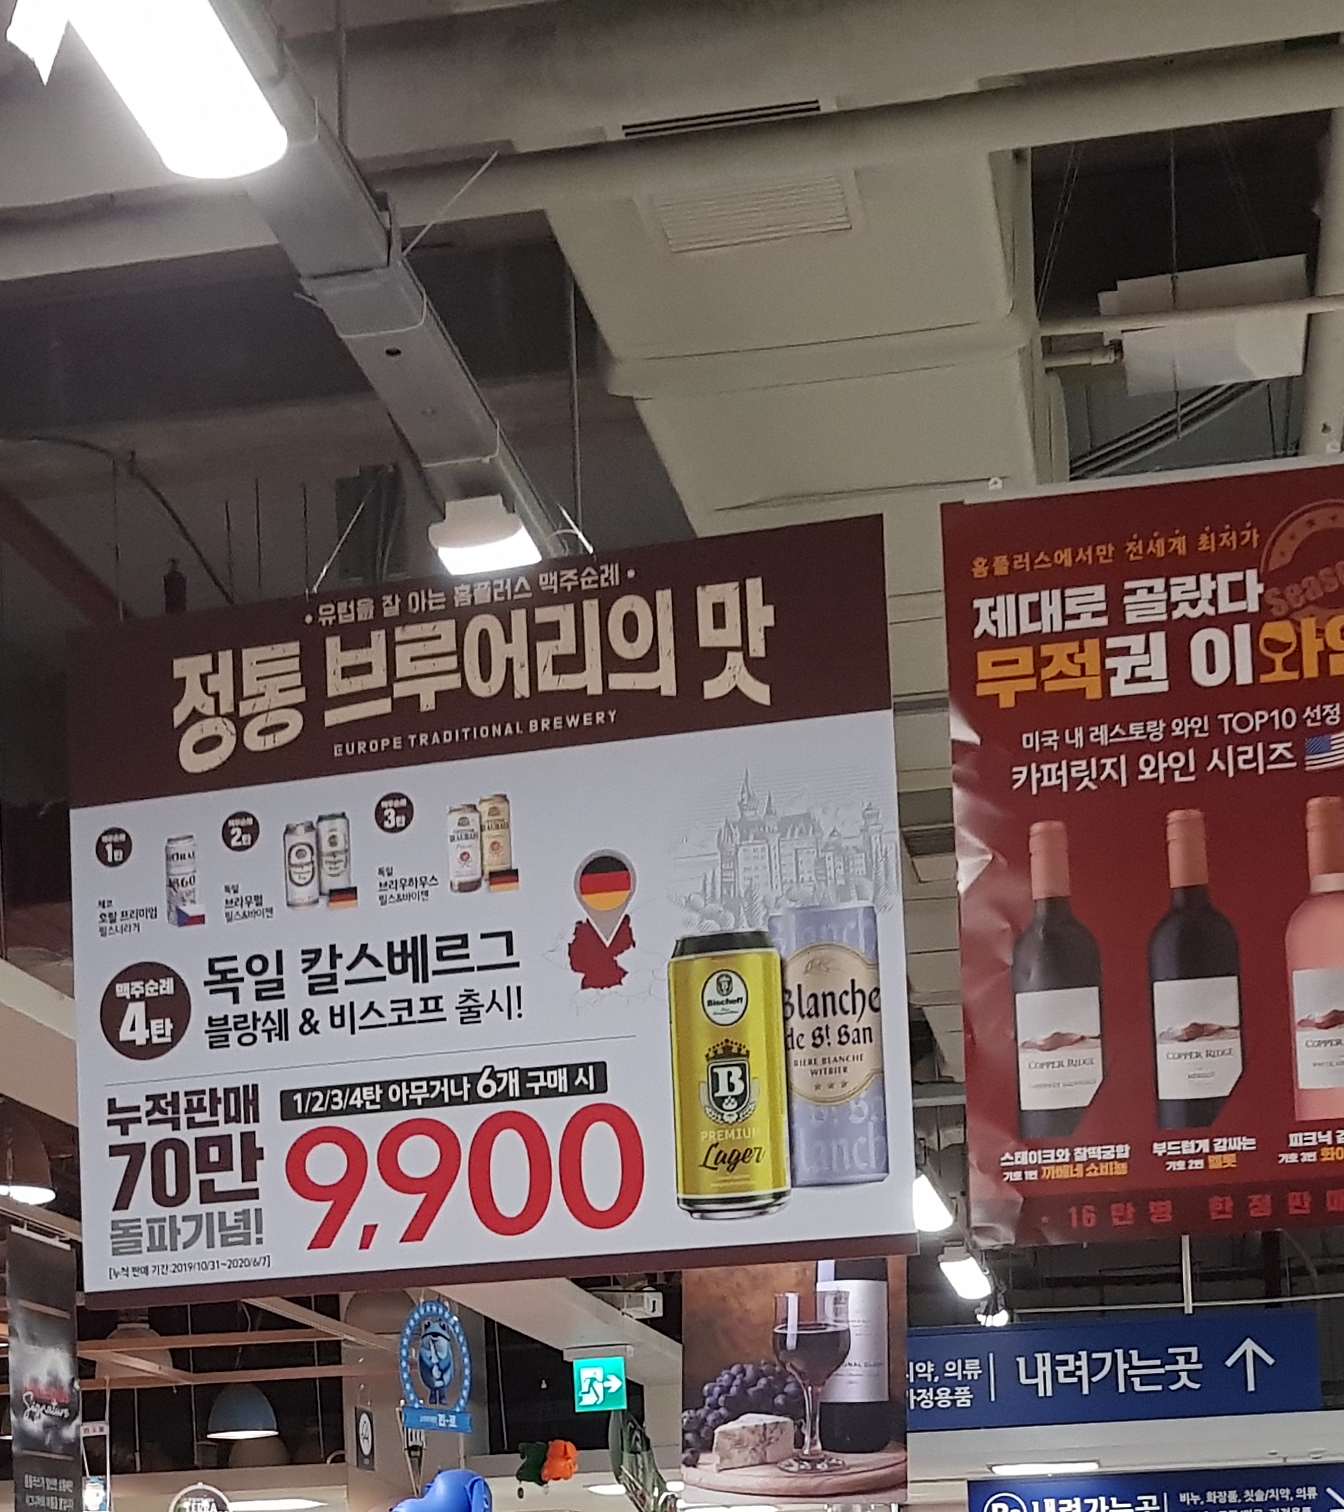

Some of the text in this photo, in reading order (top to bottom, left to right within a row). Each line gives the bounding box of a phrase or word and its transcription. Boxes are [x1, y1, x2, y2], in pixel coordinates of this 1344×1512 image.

[970, 526, 1262, 580] 홈플러스에서만 전세계 최저가
[316, 563, 622, 628] 유럽을 잘 아는 홈플러스 맥주순례
[972, 568, 1266, 640] 제대로 골랐다
[171, 576, 776, 775] 정통 브루어리의 맛
[975, 631, 1170, 708] 무적권
[333, 709, 618, 758] EUROPE TRADITIONAL BREWERY
[1021, 702, 1341, 753] 미국 내 레스토랑 와인 TOP10 선정
[1011, 741, 1298, 796] 카퍼릿지 와인 시리즈
[115, 977, 176, 999] 맥주순례
[203, 930, 521, 1006] 독일 칼스베르그
[118, 1000, 174, 1047] 4탄
[203, 985, 523, 1050] 블랑쉐 & 비스코프 출시!
[836, 1024, 875, 1046] San
[106, 1083, 261, 1138] 누적판매
[290, 1066, 596, 1116] 1/2/3/4탄 아무거나 6개 구매 시
[698, 1142, 767, 1174] Lager
[700, 1126, 760, 1143] PREMIUM
[999, 1147, 1071, 1167] 스테이크와
[1152, 1139, 1211, 1157] 부드럽게
[1287, 1131, 1334, 1149] 피크닉
[108, 1131, 265, 1213] 70만
[284, 1102, 646, 1251] 9,900
[109, 1207, 265, 1257] 돌파기념!
[944, 1358, 983, 1380] 의류
[1015, 1345, 1204, 1398] 내려가는곳
[1179, 1493, 1204, 1506] 비누,
[1206, 1489, 1242, 1504] 화장품,
[1295, 1486, 1319, 1500] 의류
